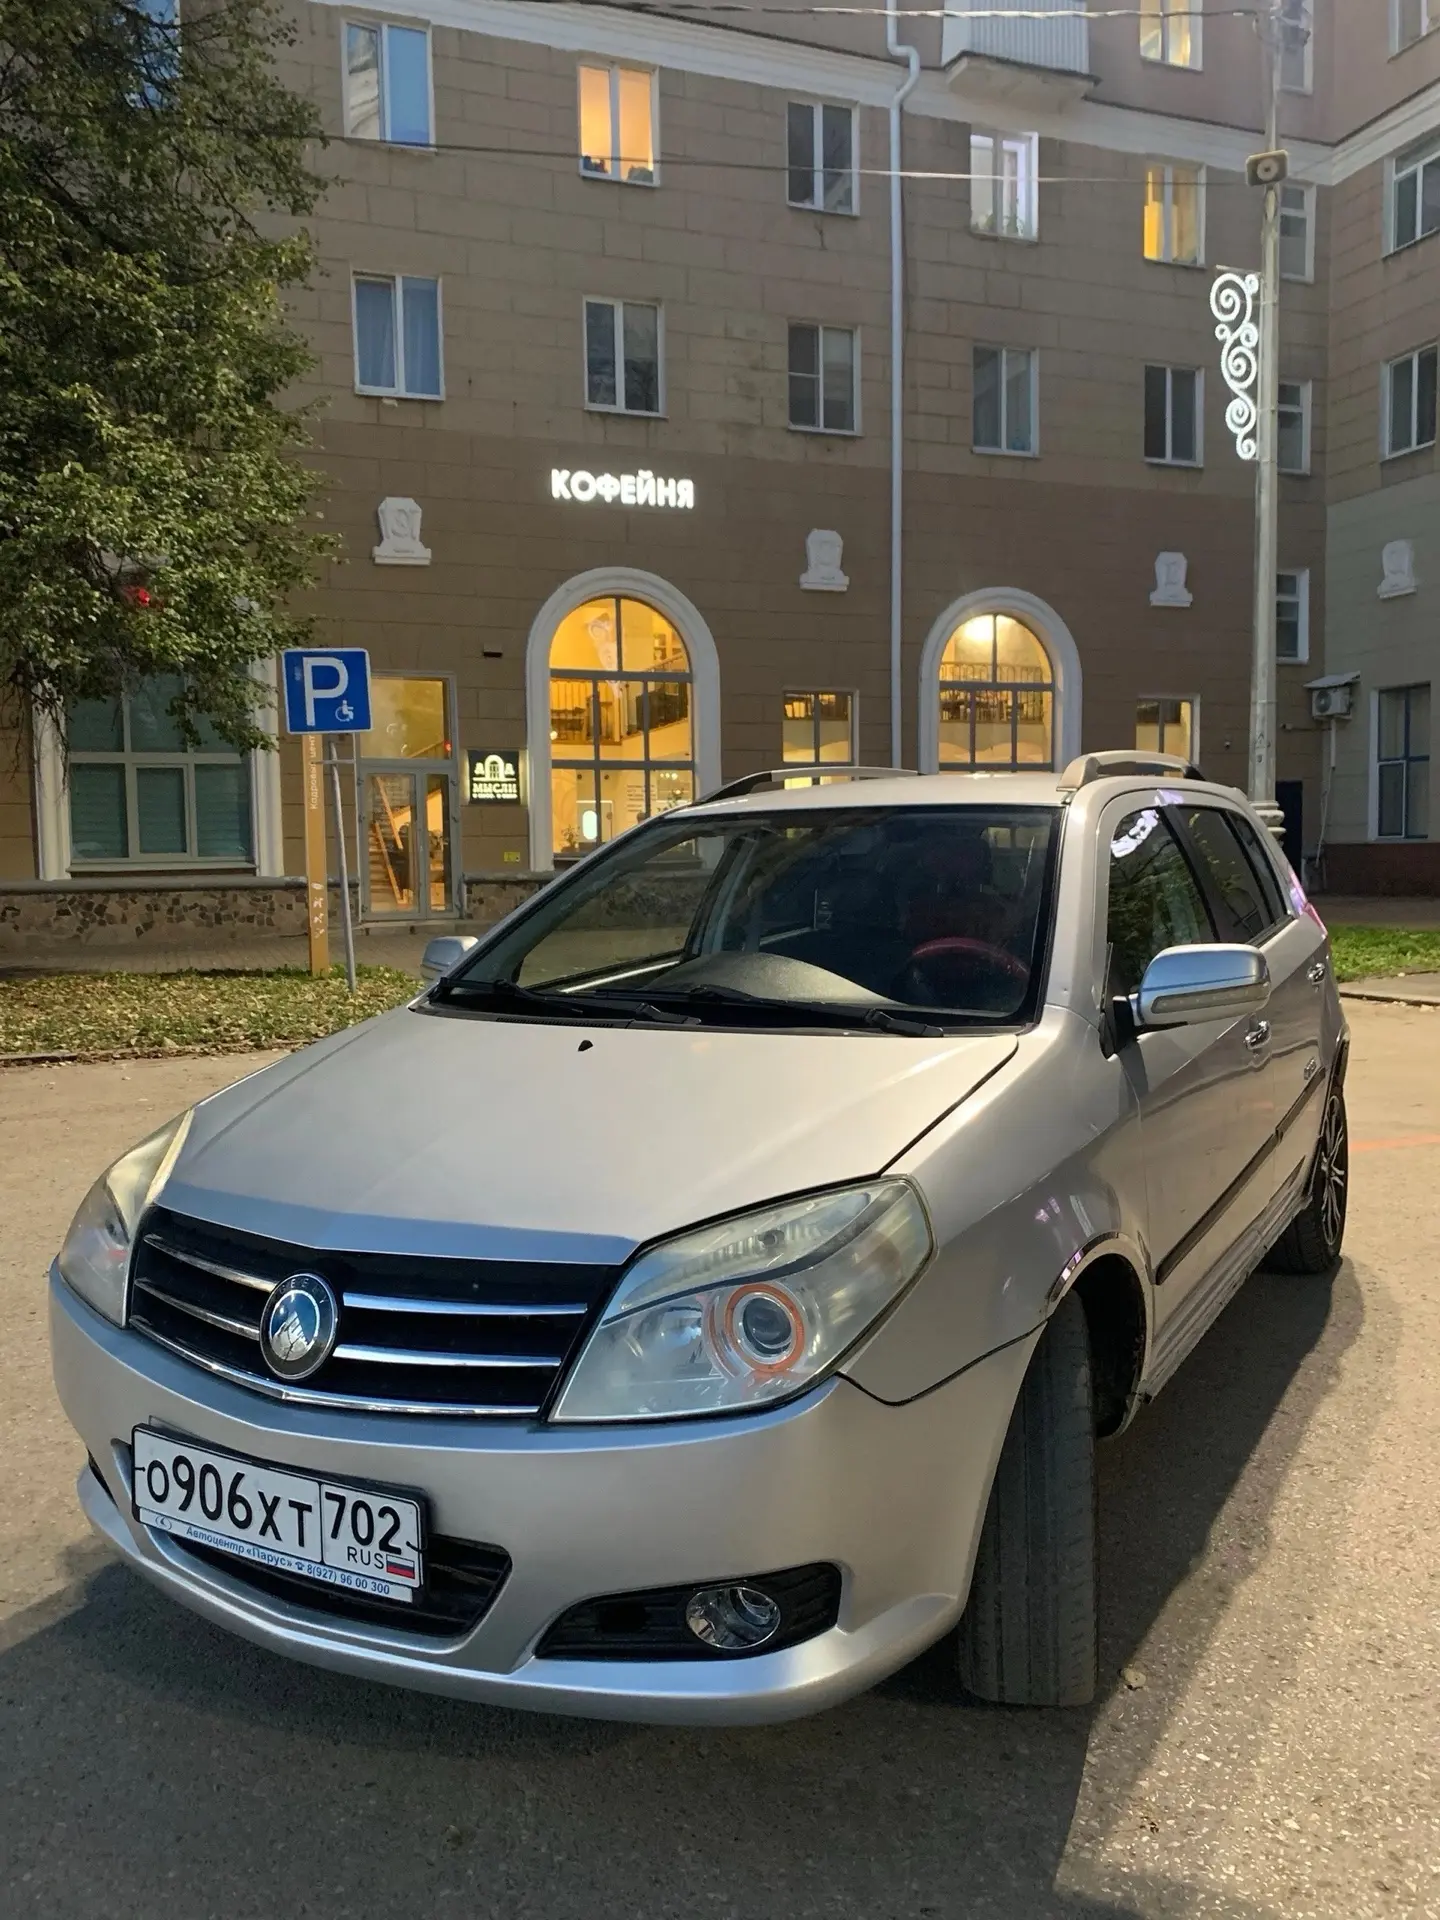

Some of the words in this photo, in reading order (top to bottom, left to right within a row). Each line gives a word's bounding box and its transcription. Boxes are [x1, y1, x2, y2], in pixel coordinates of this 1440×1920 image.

[551, 468, 694, 509] КОФЕЙНЯ
[303, 656, 348, 726] P
[146, 1454, 313, 1548] О906ХТ
[325, 1491, 402, 1556] 702
[186, 1525, 245, 1555] Автоцентр
[246, 1546, 293, 1567] «Парус»
[306, 1563, 338, 1584] 8(927)
[340, 1573, 353, 1586] 96
[355, 1577, 368, 1590] 00
[371, 1581, 390, 1595] 300
[346, 1545, 385, 1570] RUS
